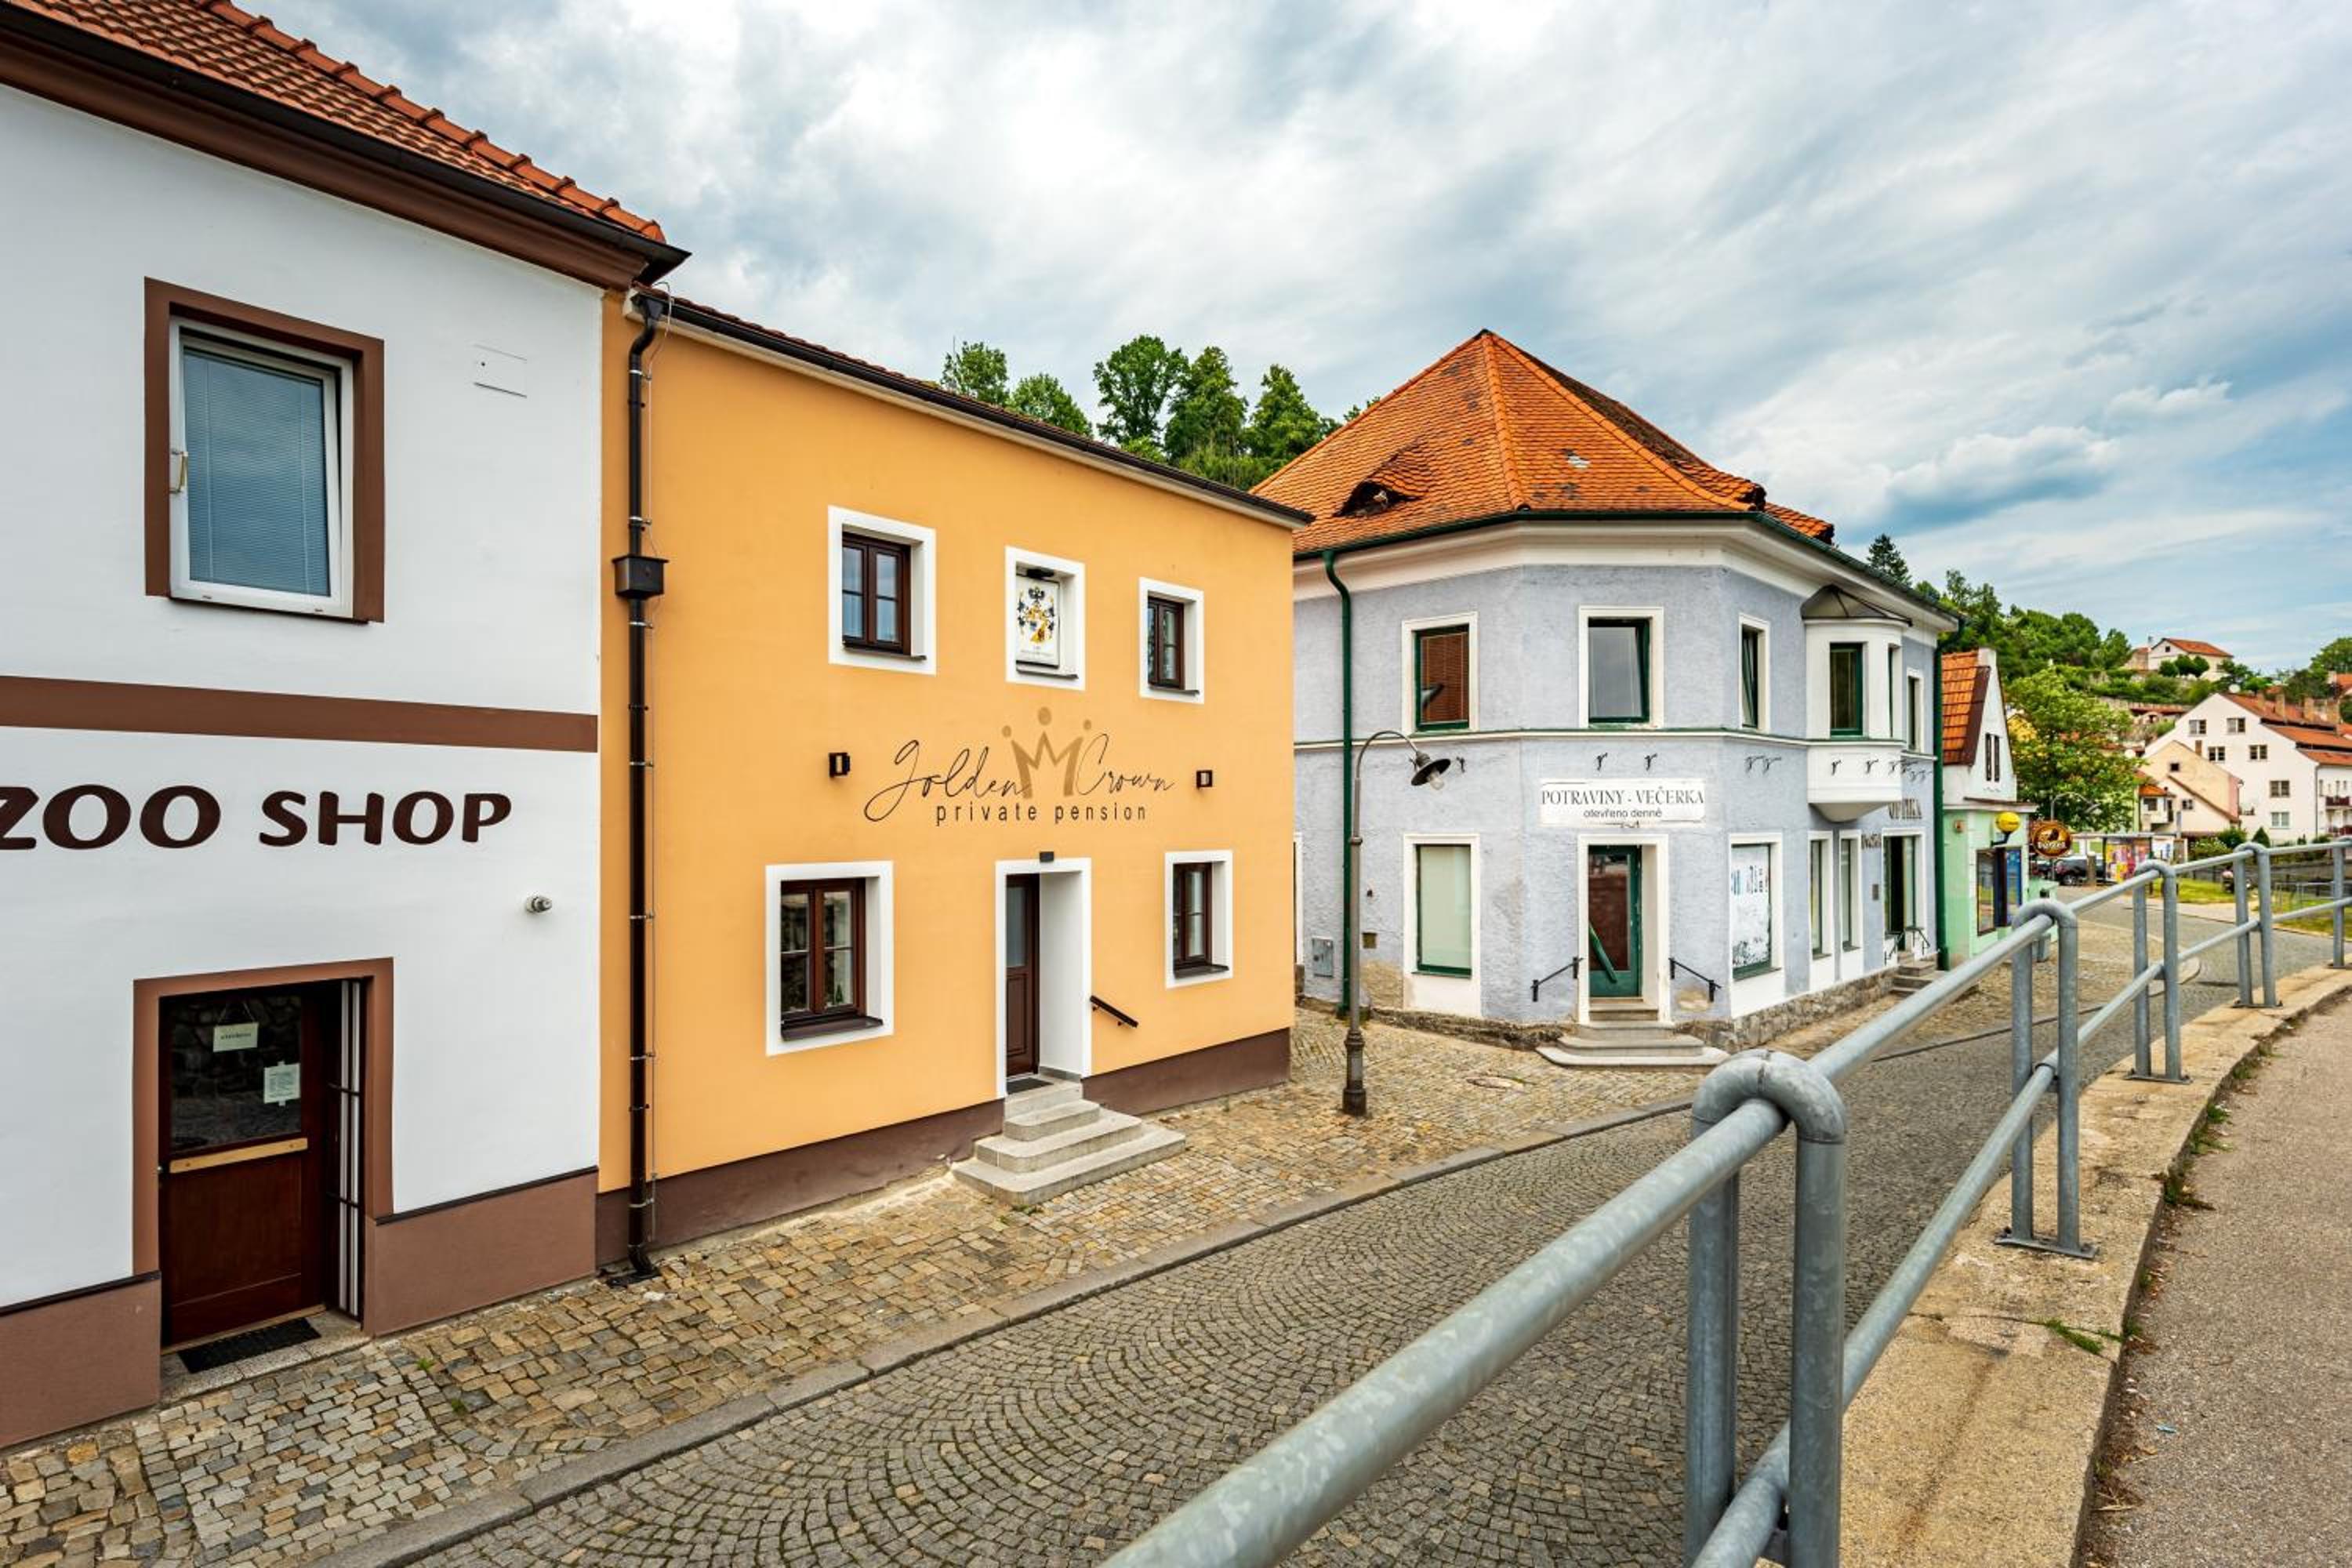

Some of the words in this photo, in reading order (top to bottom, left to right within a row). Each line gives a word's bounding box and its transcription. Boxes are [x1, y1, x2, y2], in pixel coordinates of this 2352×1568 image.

[864, 739, 1029, 822] Golden
[1077, 733, 1174, 795] Crown
[1541, 789, 1623, 805] POTRAVINY
[1635, 786, 1704, 804] VEČERKA
[0, 784, 221, 850] ZOO
[259, 790, 512, 847] SHOP
[936, 801, 1037, 826] private
[1054, 802, 1146, 824] pension
